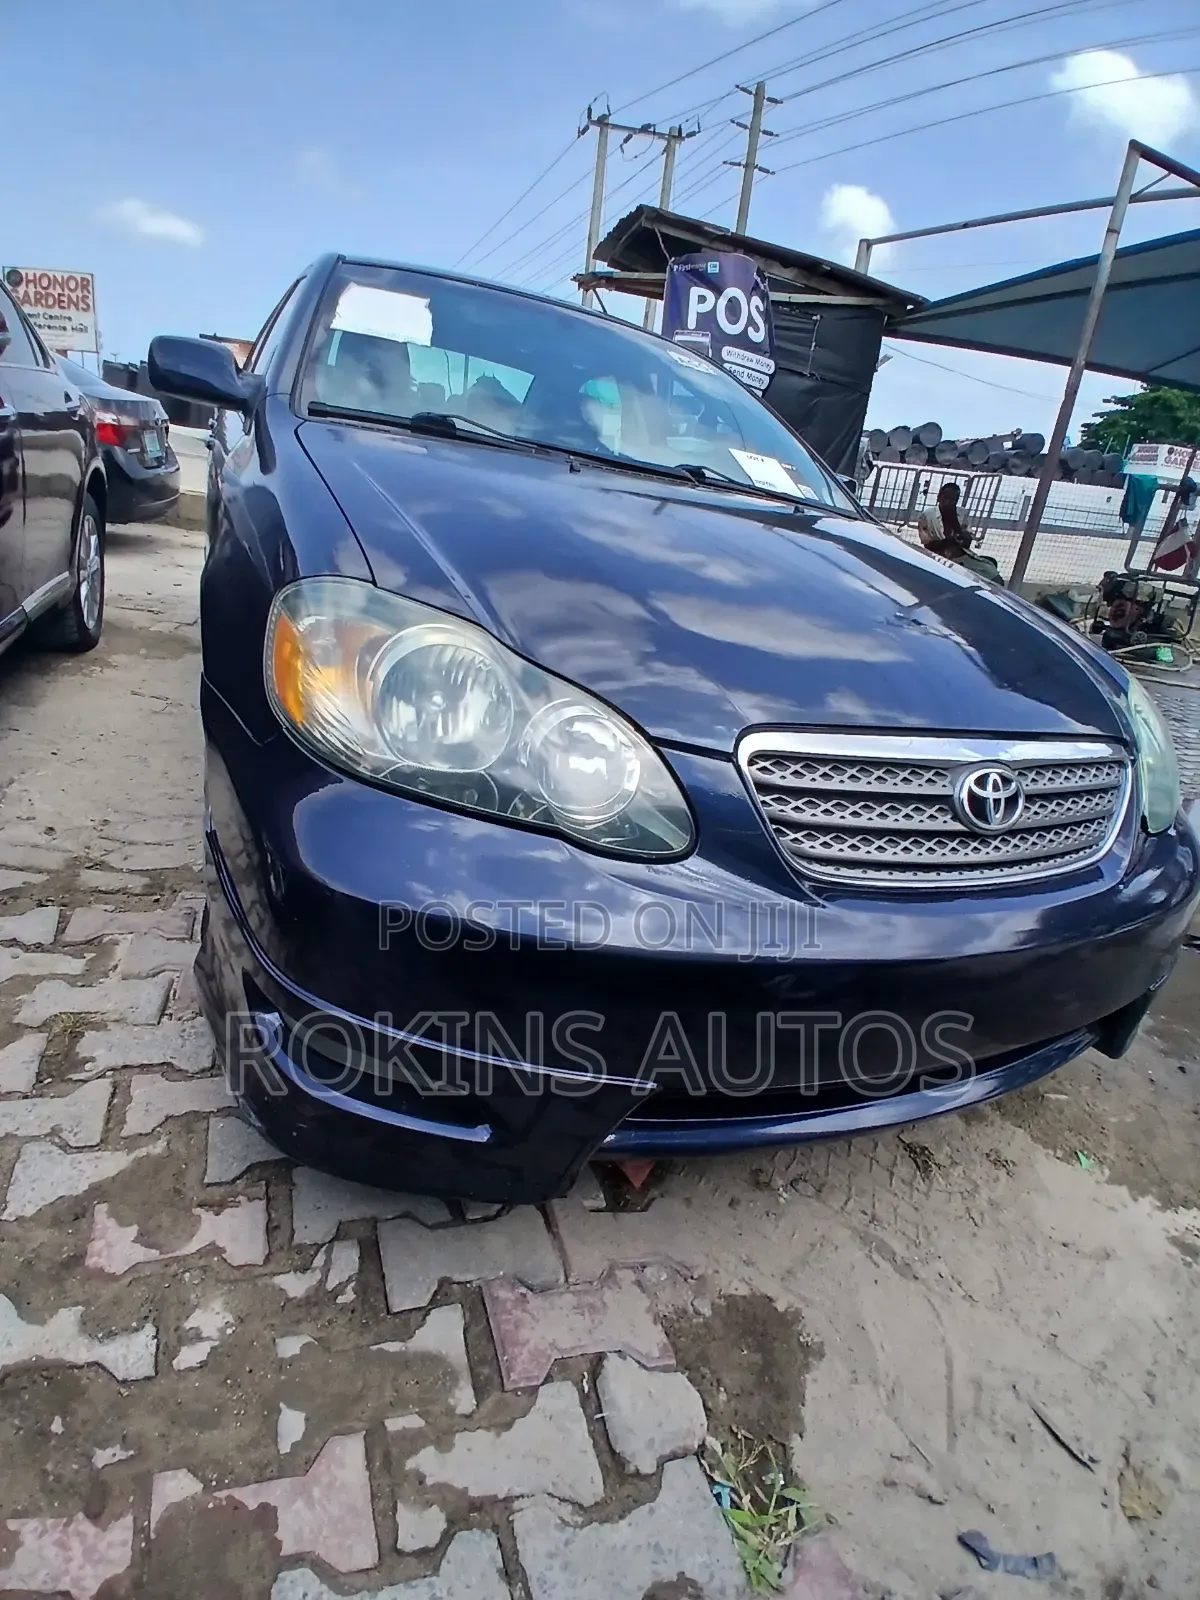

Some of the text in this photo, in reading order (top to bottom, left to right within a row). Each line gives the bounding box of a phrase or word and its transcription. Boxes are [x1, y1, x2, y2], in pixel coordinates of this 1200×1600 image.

[24, 272, 91, 295] HONOR
[42, 312, 73, 322] Centre
[687, 286, 765, 343] POS
[71, 324, 89, 334] Hall
[726, 349, 772, 372] Withdraw Money
[728, 366, 764, 387] Send Money
